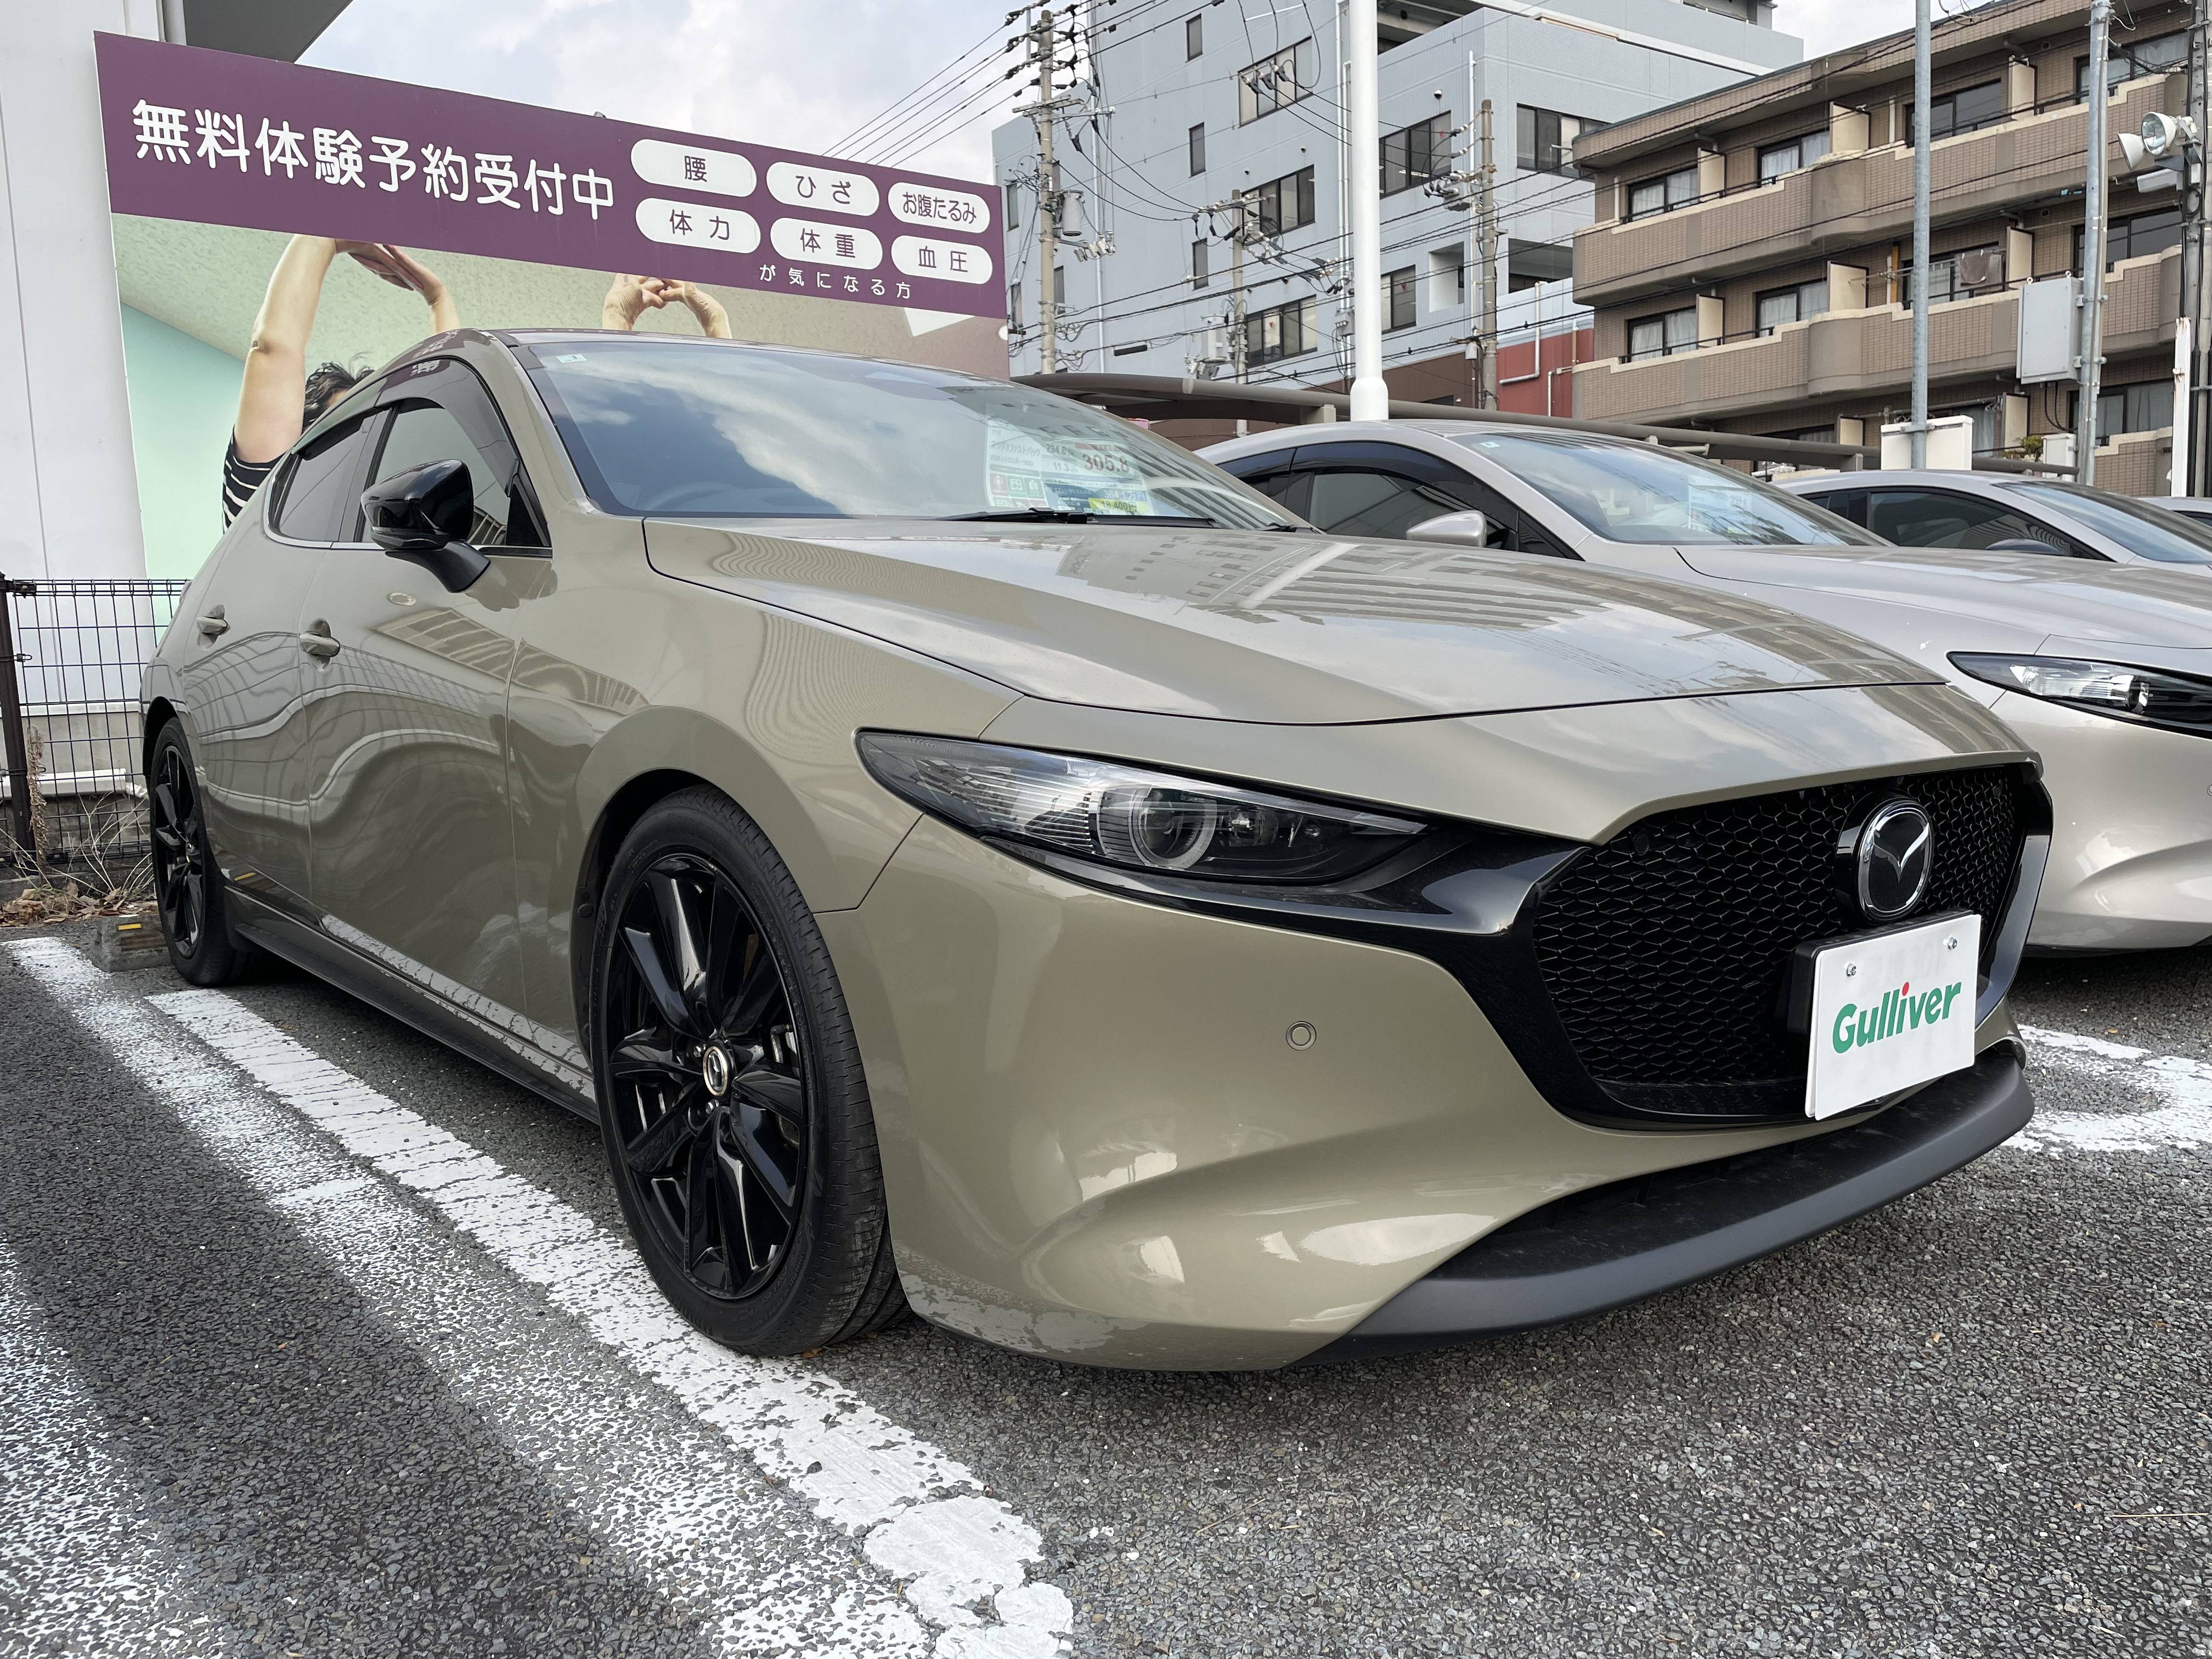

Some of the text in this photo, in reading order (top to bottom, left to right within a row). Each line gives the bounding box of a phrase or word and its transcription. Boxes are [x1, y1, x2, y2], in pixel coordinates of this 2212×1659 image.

[132, 99, 614, 220] 無料体験予約受付中
[684, 155, 707, 183] 腰
[795, 175, 851, 205] ひざ
[902, 191, 977, 224] お腹たるみ
[669, 209, 730, 240] 体力
[800, 228, 856, 258] 体重
[918, 245, 968, 273] 血圧
[759, 264, 911, 299] が気になる方
[1082, 454, 1129, 473] 305.8
[1832, 981, 1962, 1054] Gulliver
